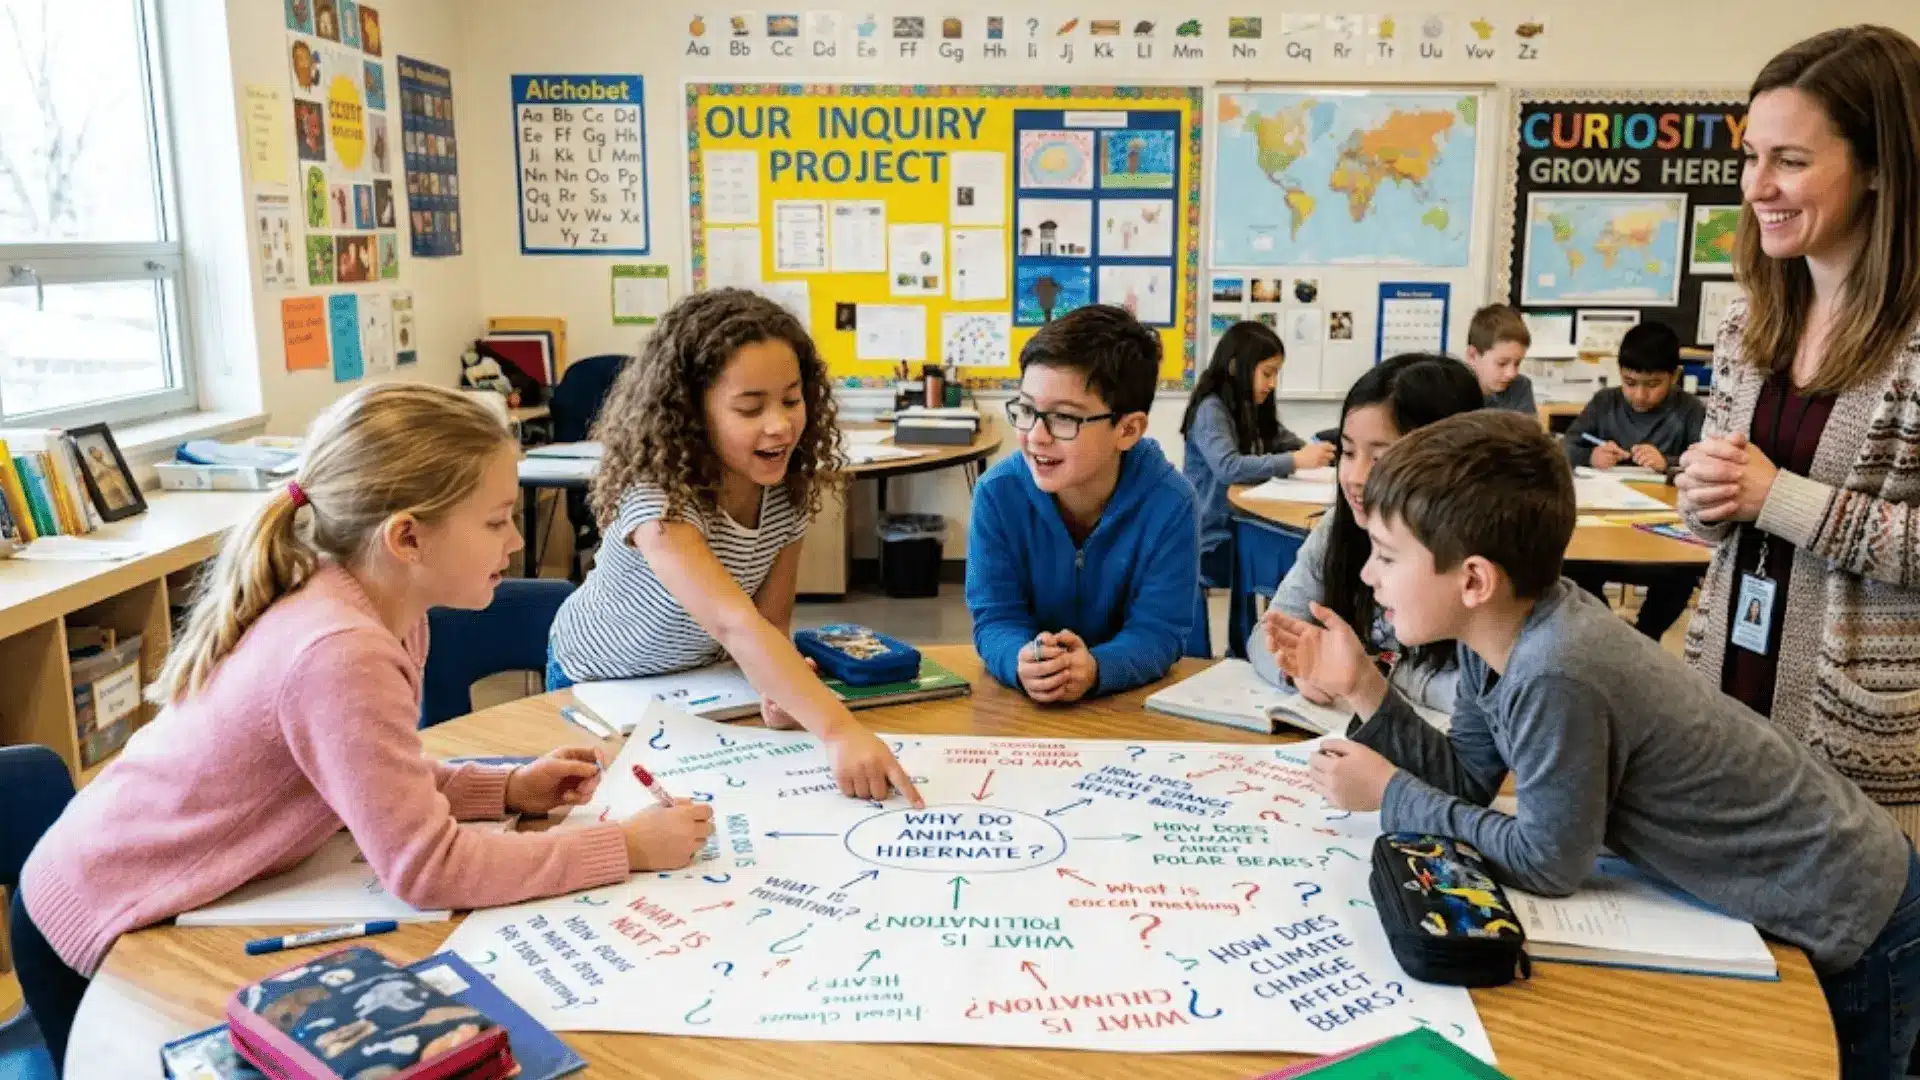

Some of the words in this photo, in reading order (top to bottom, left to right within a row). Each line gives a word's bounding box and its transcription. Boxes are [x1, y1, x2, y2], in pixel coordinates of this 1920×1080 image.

[685, 41, 710, 57] Aa
[729, 41, 751, 57] Bb
[771, 41, 793, 57] Cc
[813, 41, 836, 57] Dd
[857, 41, 878, 57] Ee
[899, 41, 917, 57] Ff
[938, 41, 964, 63] Gg
[984, 41, 1007, 57] Hh
[1059, 42, 1074, 63] Jj
[1094, 42, 1115, 58] Kk
[1137, 42, 1153, 58] Ll
[1173, 42, 1203, 58] Mm
[1233, 42, 1256, 58] Nn
[1334, 42, 1352, 58] Rr
[1376, 42, 1394, 58] Tt
[1420, 42, 1443, 58] Uu
[1518, 43, 1538, 59] Zz
[522, 107, 543, 123] Aa
[553, 107, 574, 123] Bb
[582, 107, 604, 122] Cc
[614, 107, 636, 123] Dd
[705, 106, 791, 139] OUR
[818, 106, 987, 144] INQUIRY
[523, 127, 543, 143] Ee
[554, 127, 572, 143] Ff
[583, 127, 606, 147] Gg
[614, 128, 637, 143] Hh
[1522, 112, 1749, 150] CURIOSITY
[554, 148, 575, 163] Kk
[588, 149, 602, 163] Ll
[612, 149, 640, 163] Mm
[524, 167, 548, 183] Nn
[555, 167, 579, 183] Nn
[585, 168, 610, 183] Oo
[618, 168, 638, 186] Pp
[770, 150, 947, 183] PROJECT
[1529, 157, 1642, 185] GROWS
[1661, 157, 1739, 185] HERE
[525, 188, 551, 208] Qq
[559, 188, 577, 202] Rr
[589, 188, 607, 203] Ss
[621, 188, 637, 203] Tt
[526, 208, 549, 223] Uu
[557, 208, 579, 223] Vv
[620, 208, 640, 223] Xx
[560, 227, 580, 247] Yy
[589, 228, 608, 244] Zz
[905, 813, 963, 826] WHY
[978, 813, 1013, 826] DO
[1153, 821, 1202, 834] HOW
[1213, 823, 1268, 835] DOES
[896, 828, 1014, 842] ANIMALS
[1153, 855, 1224, 866] POLAR
[1106, 882, 1167, 895] What
[1180, 885, 1200, 896] is
[941, 932, 967, 947] IS
[987, 934, 1075, 950] WHAT
[1208, 934, 1272, 964] HOW
[1274, 914, 1340, 941] DOES
[1250, 933, 1354, 975] CLIMATE
[1253, 956, 1356, 999] CHANGE
[1289, 971, 1373, 1013] AFFECT
[1040, 1017, 1073, 1034] IS
[1097, 1009, 1189, 1032] WHAT
